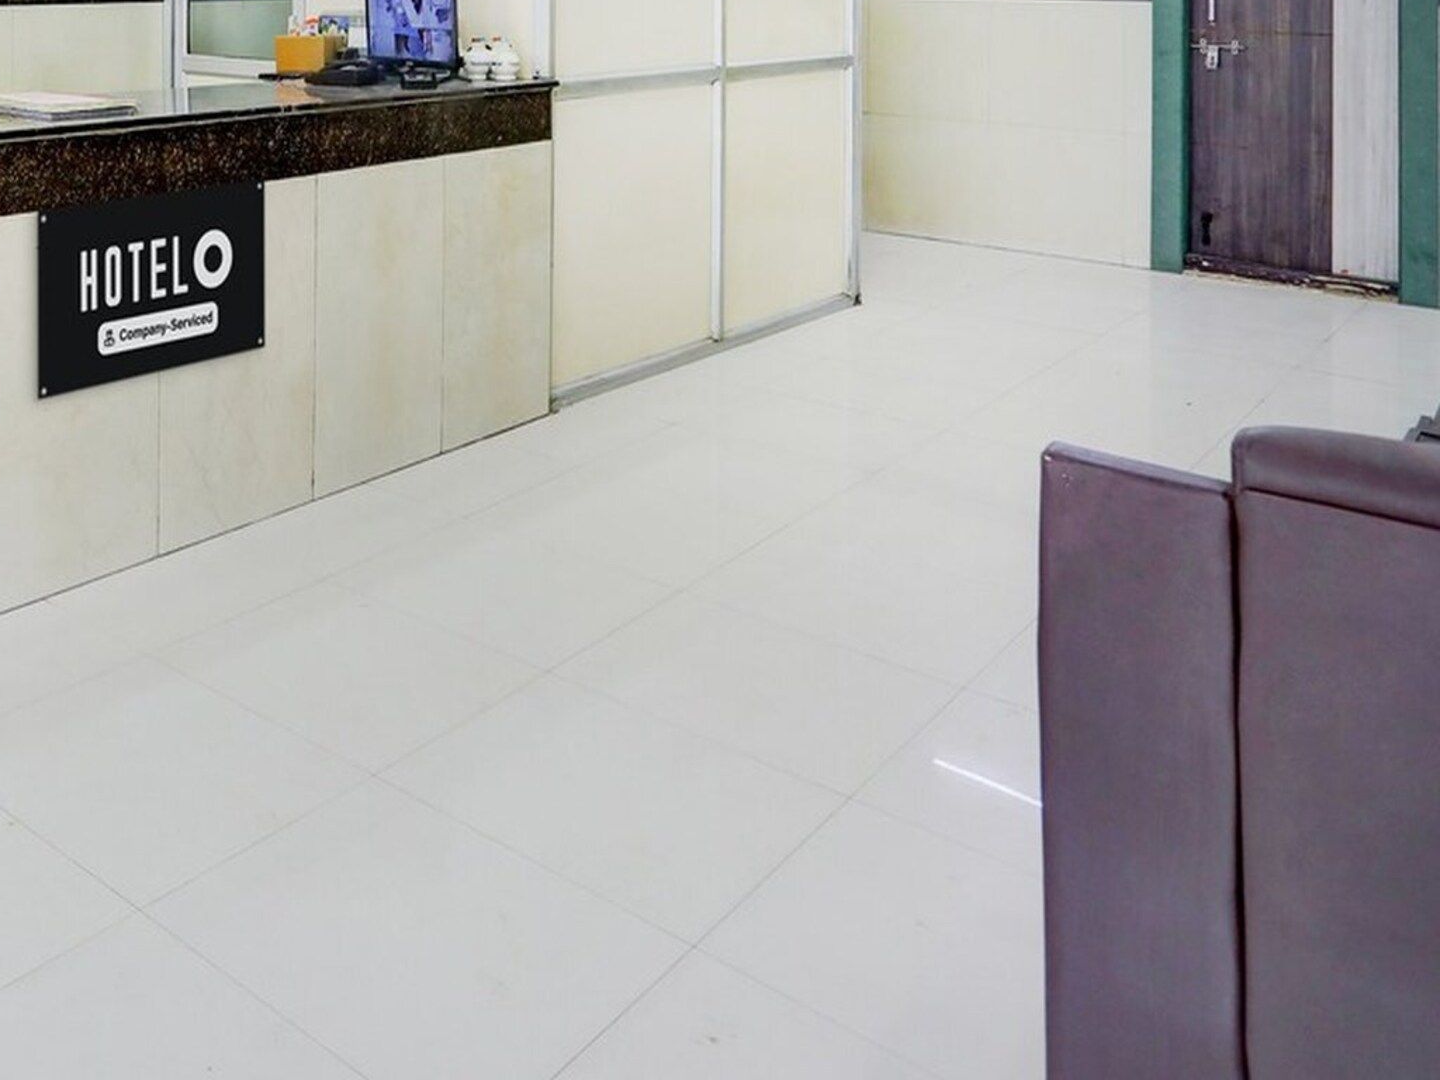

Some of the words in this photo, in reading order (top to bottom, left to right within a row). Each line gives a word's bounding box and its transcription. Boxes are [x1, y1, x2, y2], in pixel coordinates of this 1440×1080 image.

[79, 235, 189, 313] HOTEL
[193, 228, 233, 289] O
[119, 311, 213, 342] Company-Serviced
